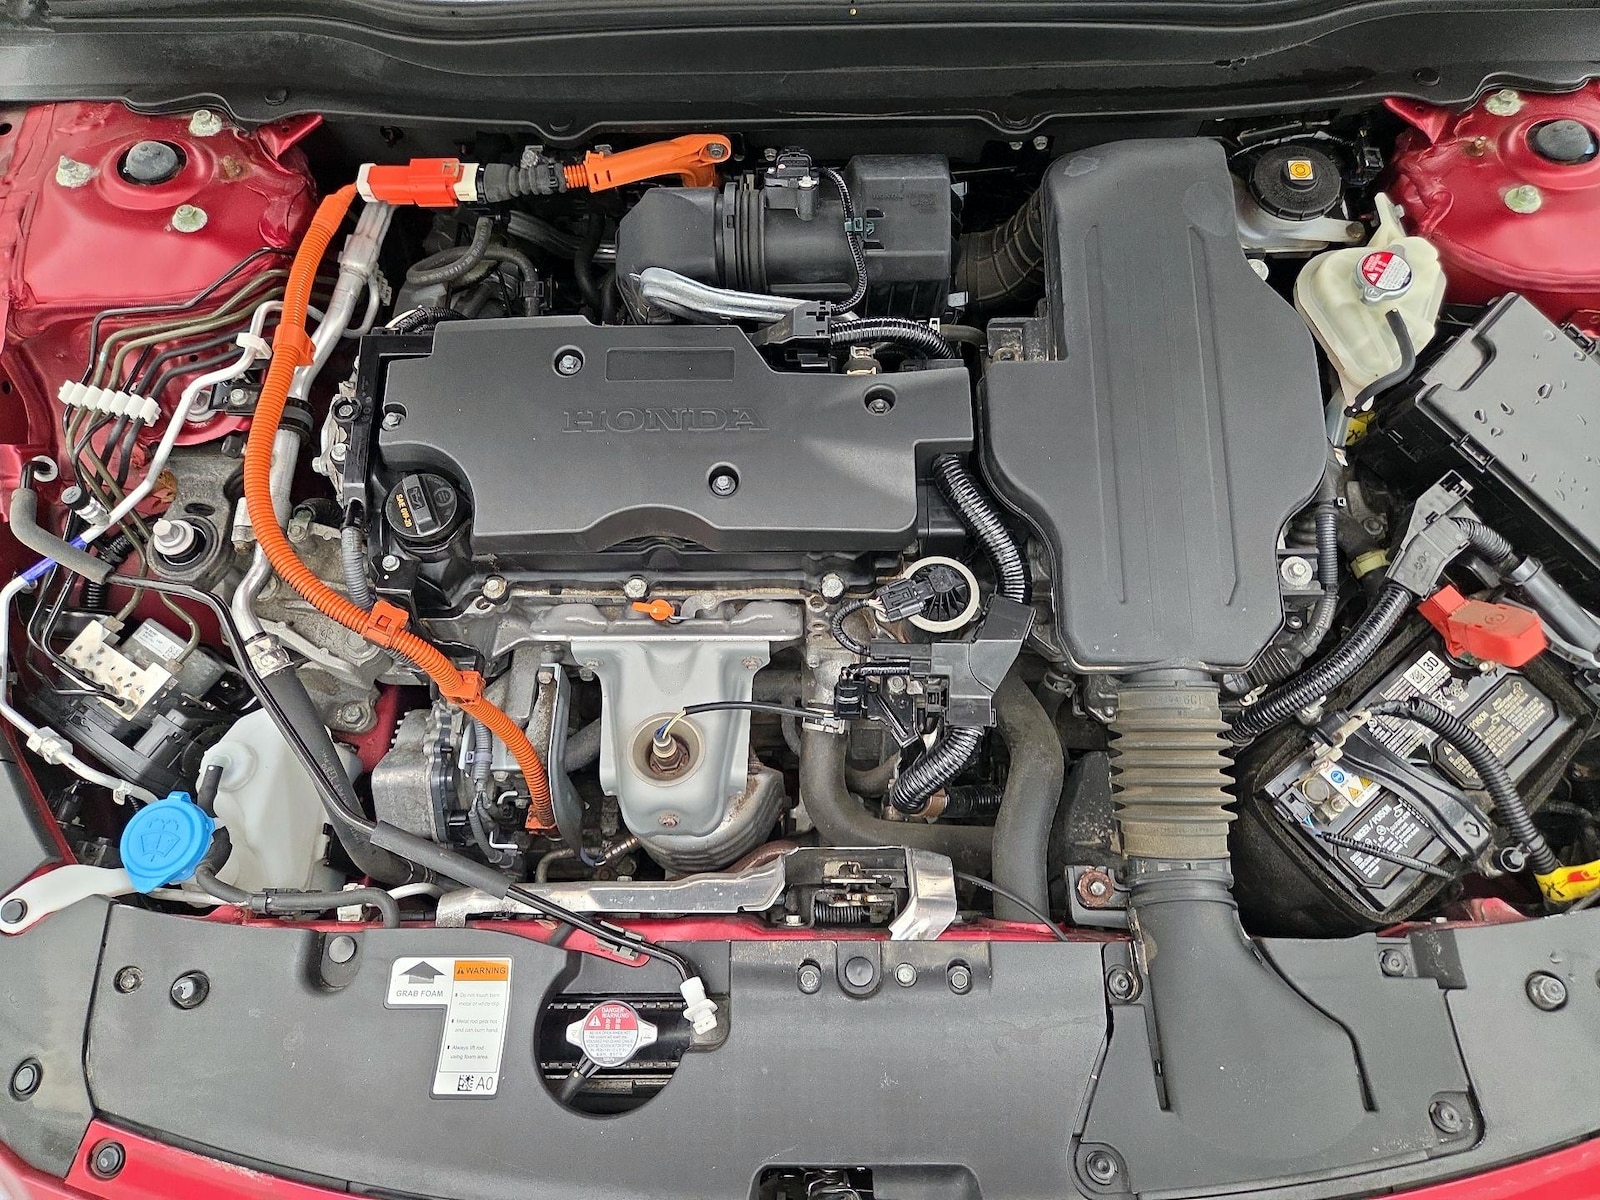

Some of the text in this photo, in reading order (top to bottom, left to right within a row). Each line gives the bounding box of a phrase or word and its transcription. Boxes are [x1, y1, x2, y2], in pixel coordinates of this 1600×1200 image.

[561, 407, 770, 433] HONDA
[396, 493, 406, 509] SAE
[1422, 656, 1439, 672] 3D
[466, 966, 506, 975] WARNING
[475, 1076, 494, 1091] A0
